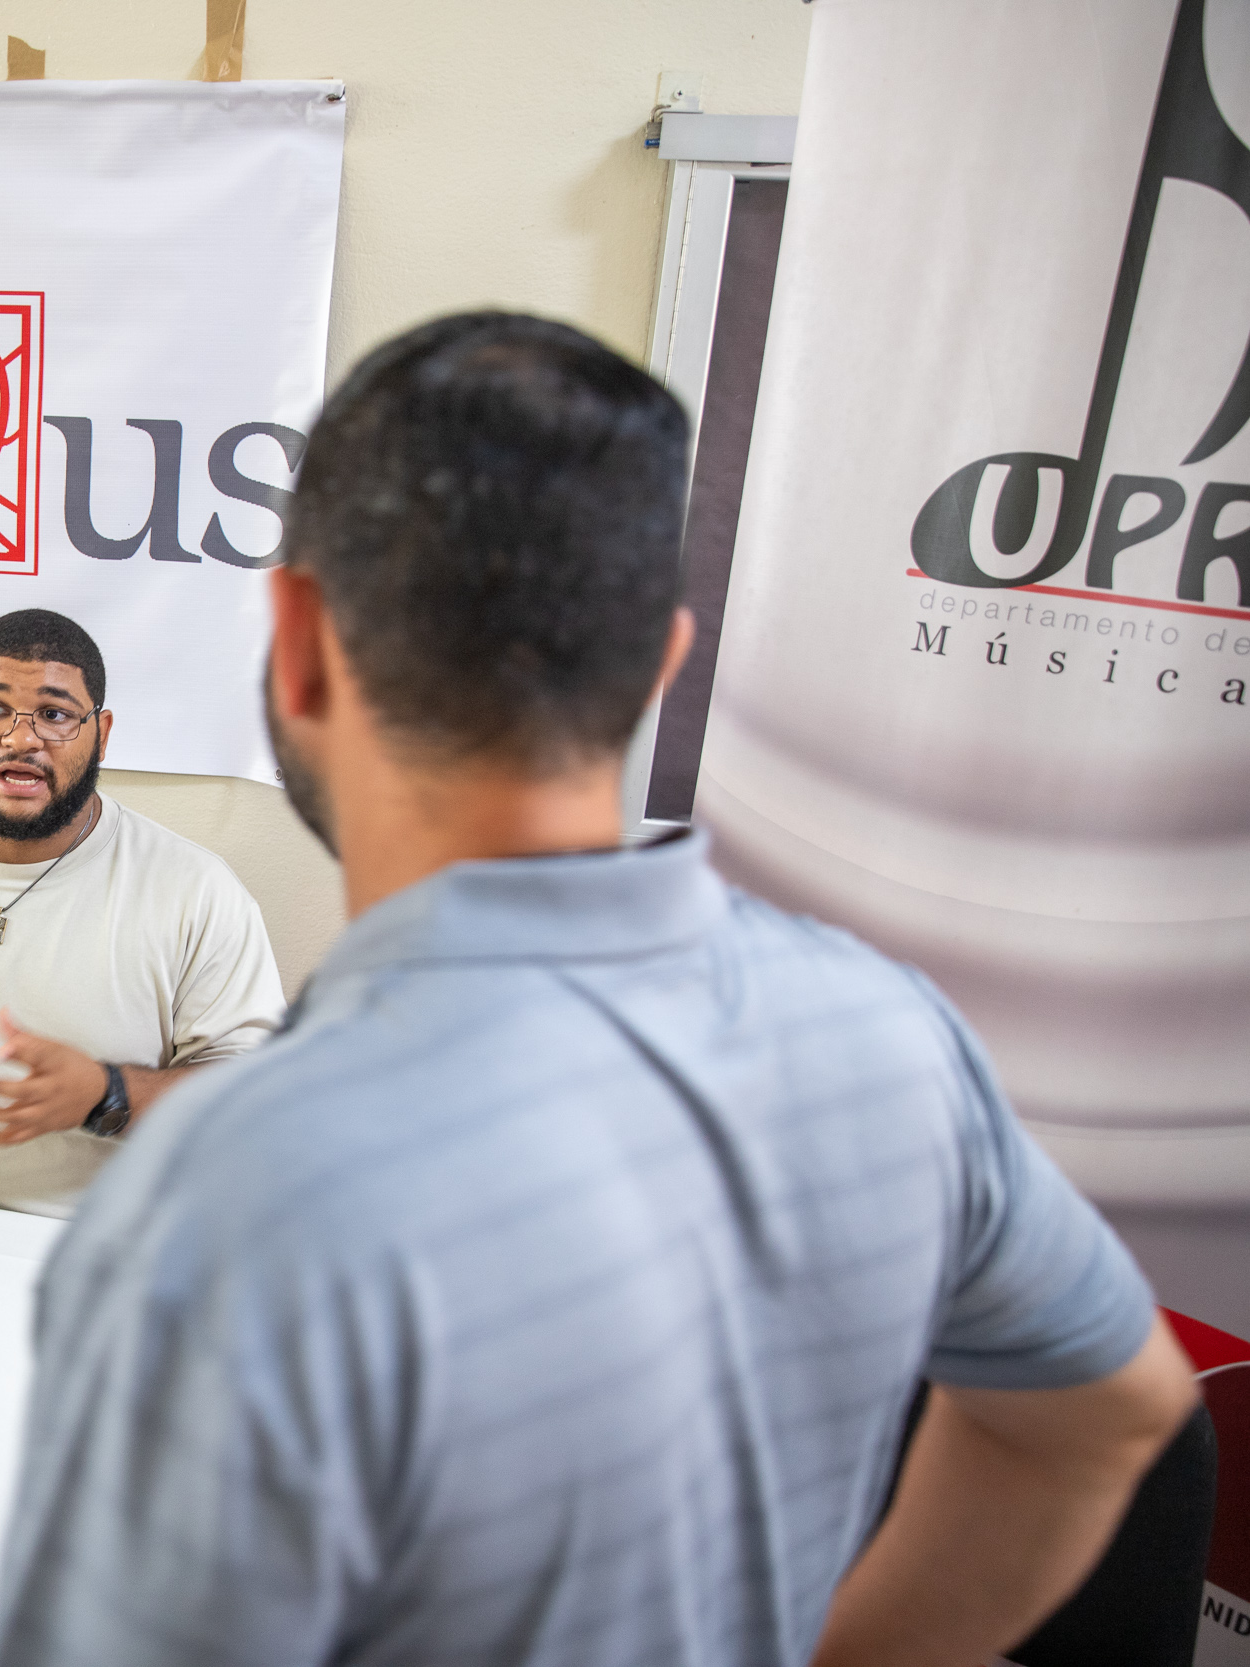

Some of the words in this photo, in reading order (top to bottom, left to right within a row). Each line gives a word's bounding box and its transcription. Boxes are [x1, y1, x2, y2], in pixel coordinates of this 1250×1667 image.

[919, 588, 1181, 648] departamento
[1204, 628, 1250, 658] de
[910, 620, 1248, 706] Música
